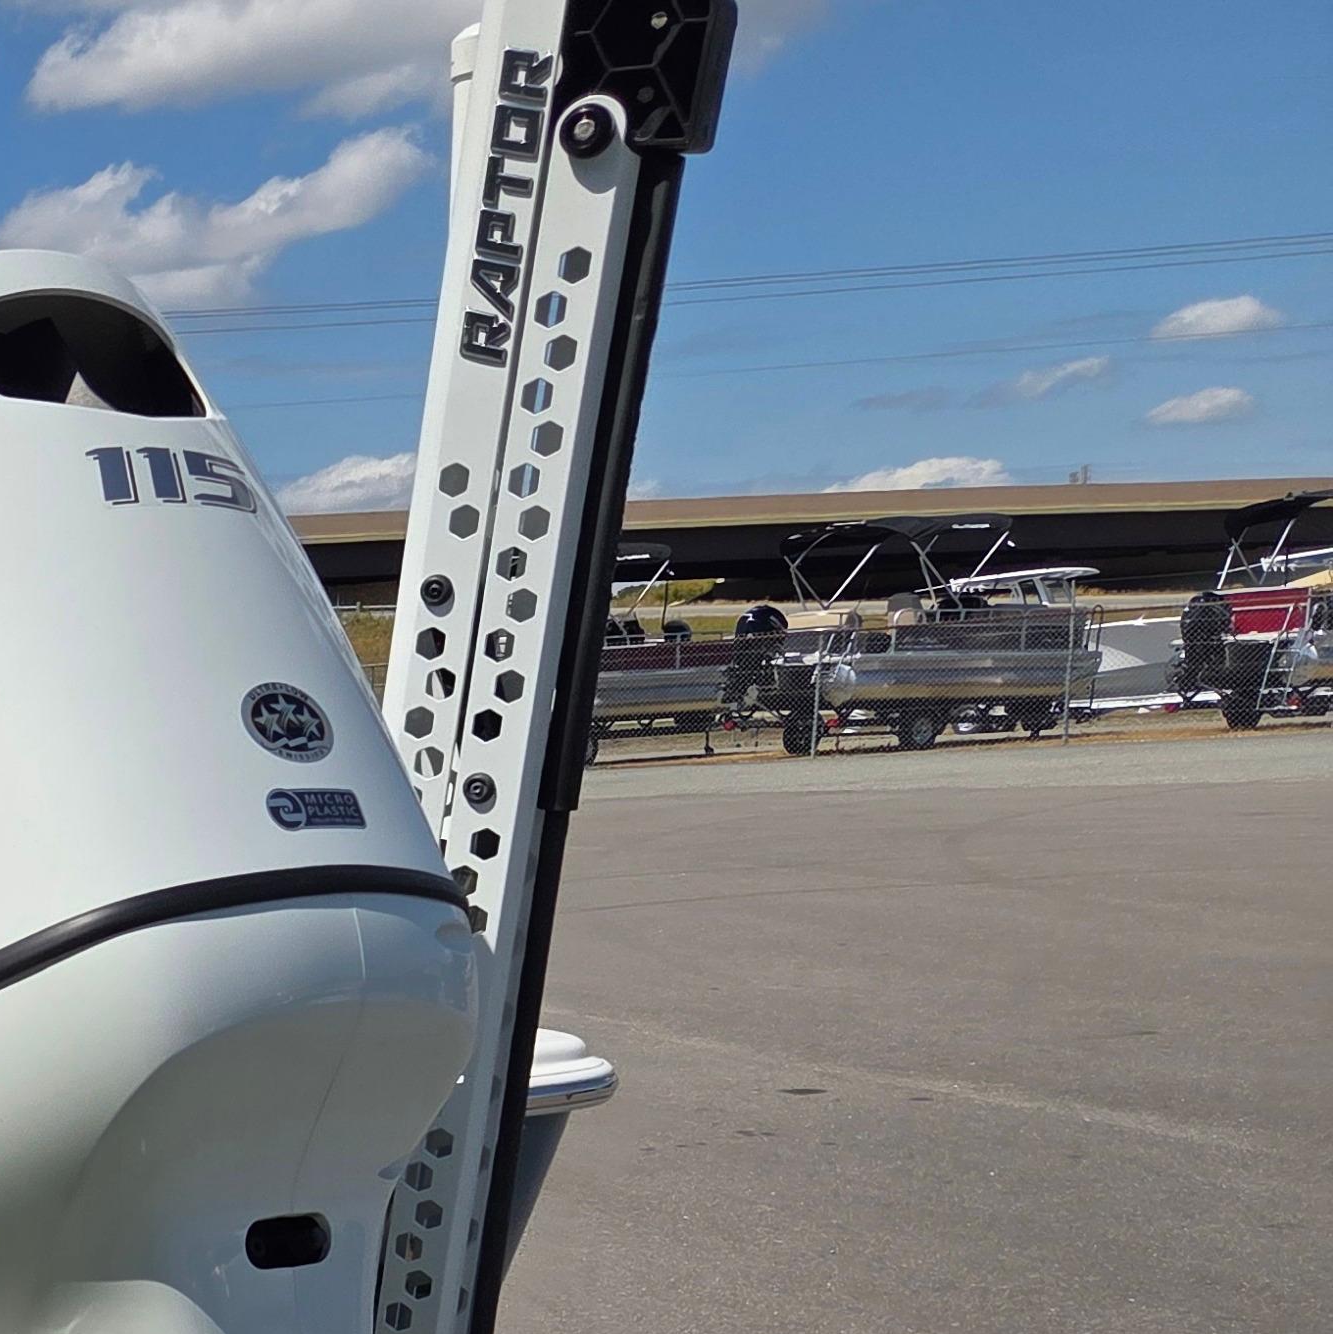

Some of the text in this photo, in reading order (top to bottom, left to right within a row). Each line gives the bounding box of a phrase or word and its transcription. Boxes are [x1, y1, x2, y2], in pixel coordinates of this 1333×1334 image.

[459, 47, 554, 368] RAPTOR
[85, 446, 258, 514] 115
[304, 793, 354, 805] MICRO
[307, 805, 360, 816] PLASTIC
